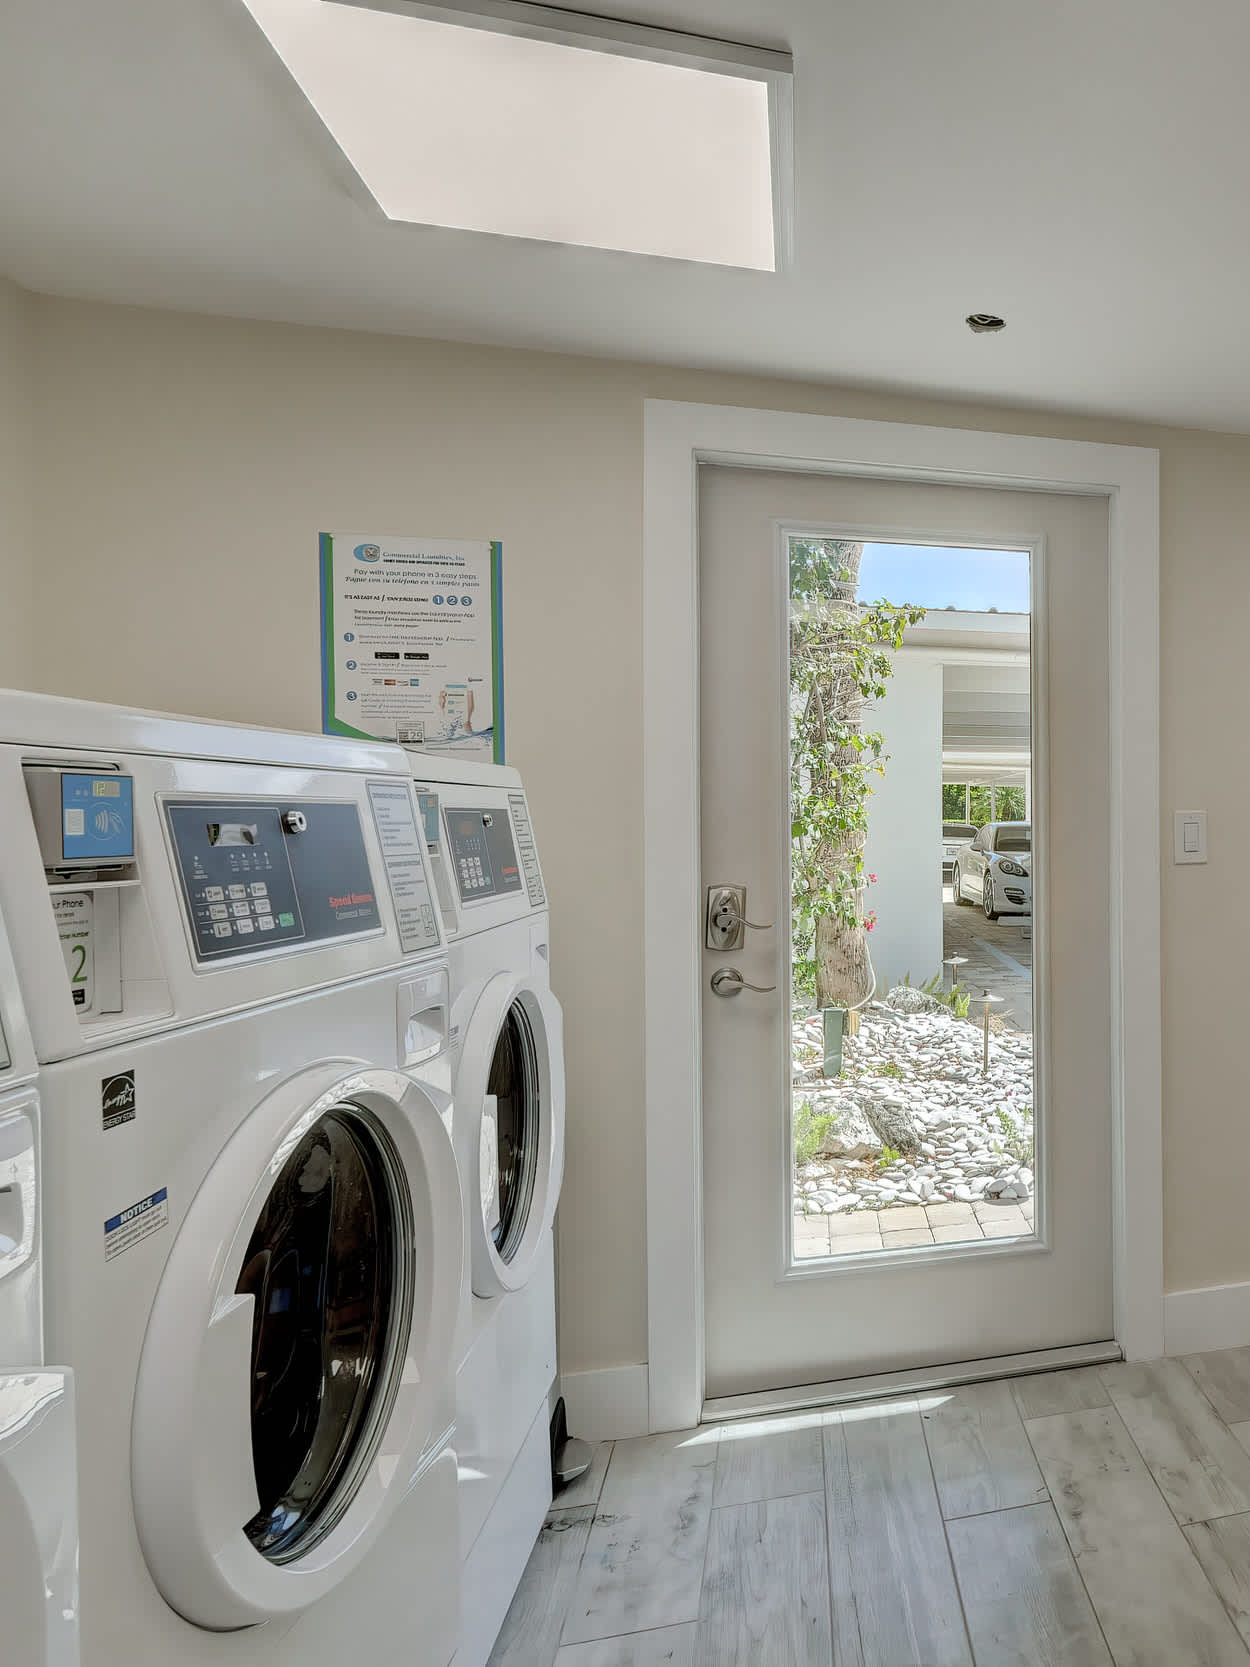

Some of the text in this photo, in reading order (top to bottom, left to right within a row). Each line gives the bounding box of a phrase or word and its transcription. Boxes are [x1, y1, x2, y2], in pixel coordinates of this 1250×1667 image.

[353, 568, 368, 576] Pay
[386, 570, 401, 578] your
[402, 570, 426, 578] phone
[62, 899, 84, 909] Phone
[71, 944, 88, 983] 2
[103, 1114, 123, 1130] ENERGY
[120, 1197, 153, 1224] NOTICE
